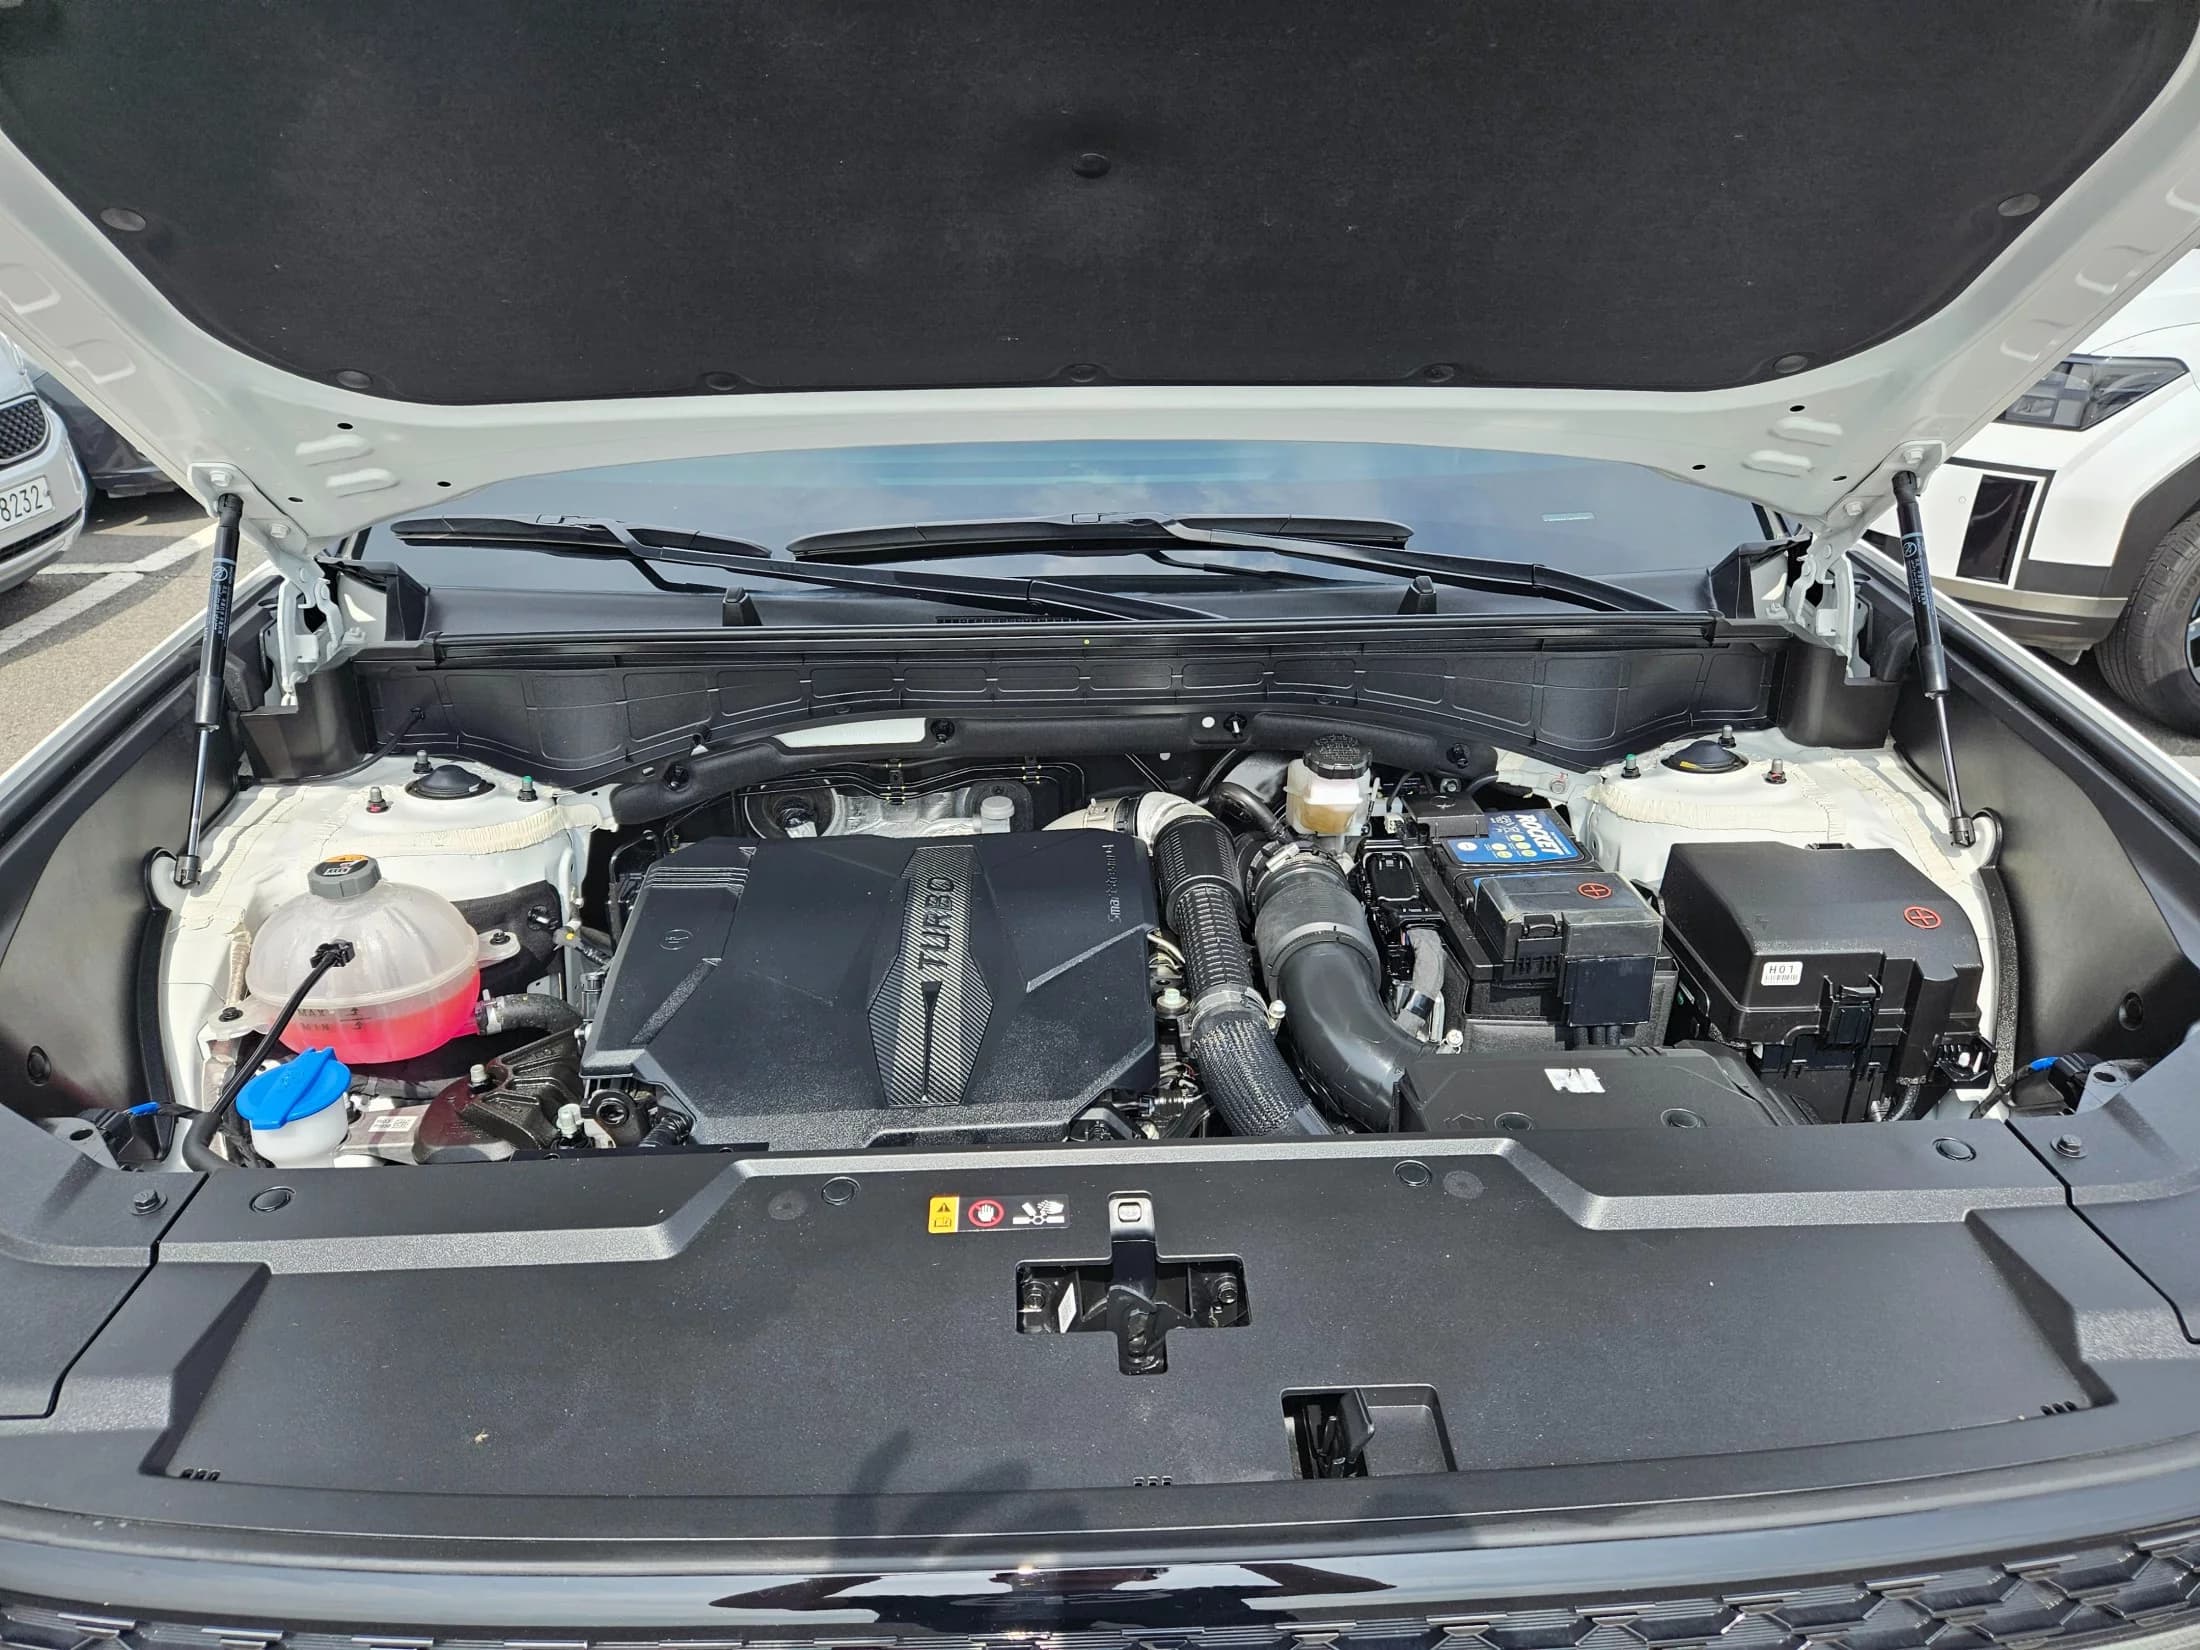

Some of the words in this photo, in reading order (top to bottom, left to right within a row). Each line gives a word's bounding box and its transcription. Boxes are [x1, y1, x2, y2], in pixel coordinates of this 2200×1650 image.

[0, 484, 43, 522] 8232
[1515, 814, 1566, 855] ROCKET
[917, 877, 954, 970] TURBO
